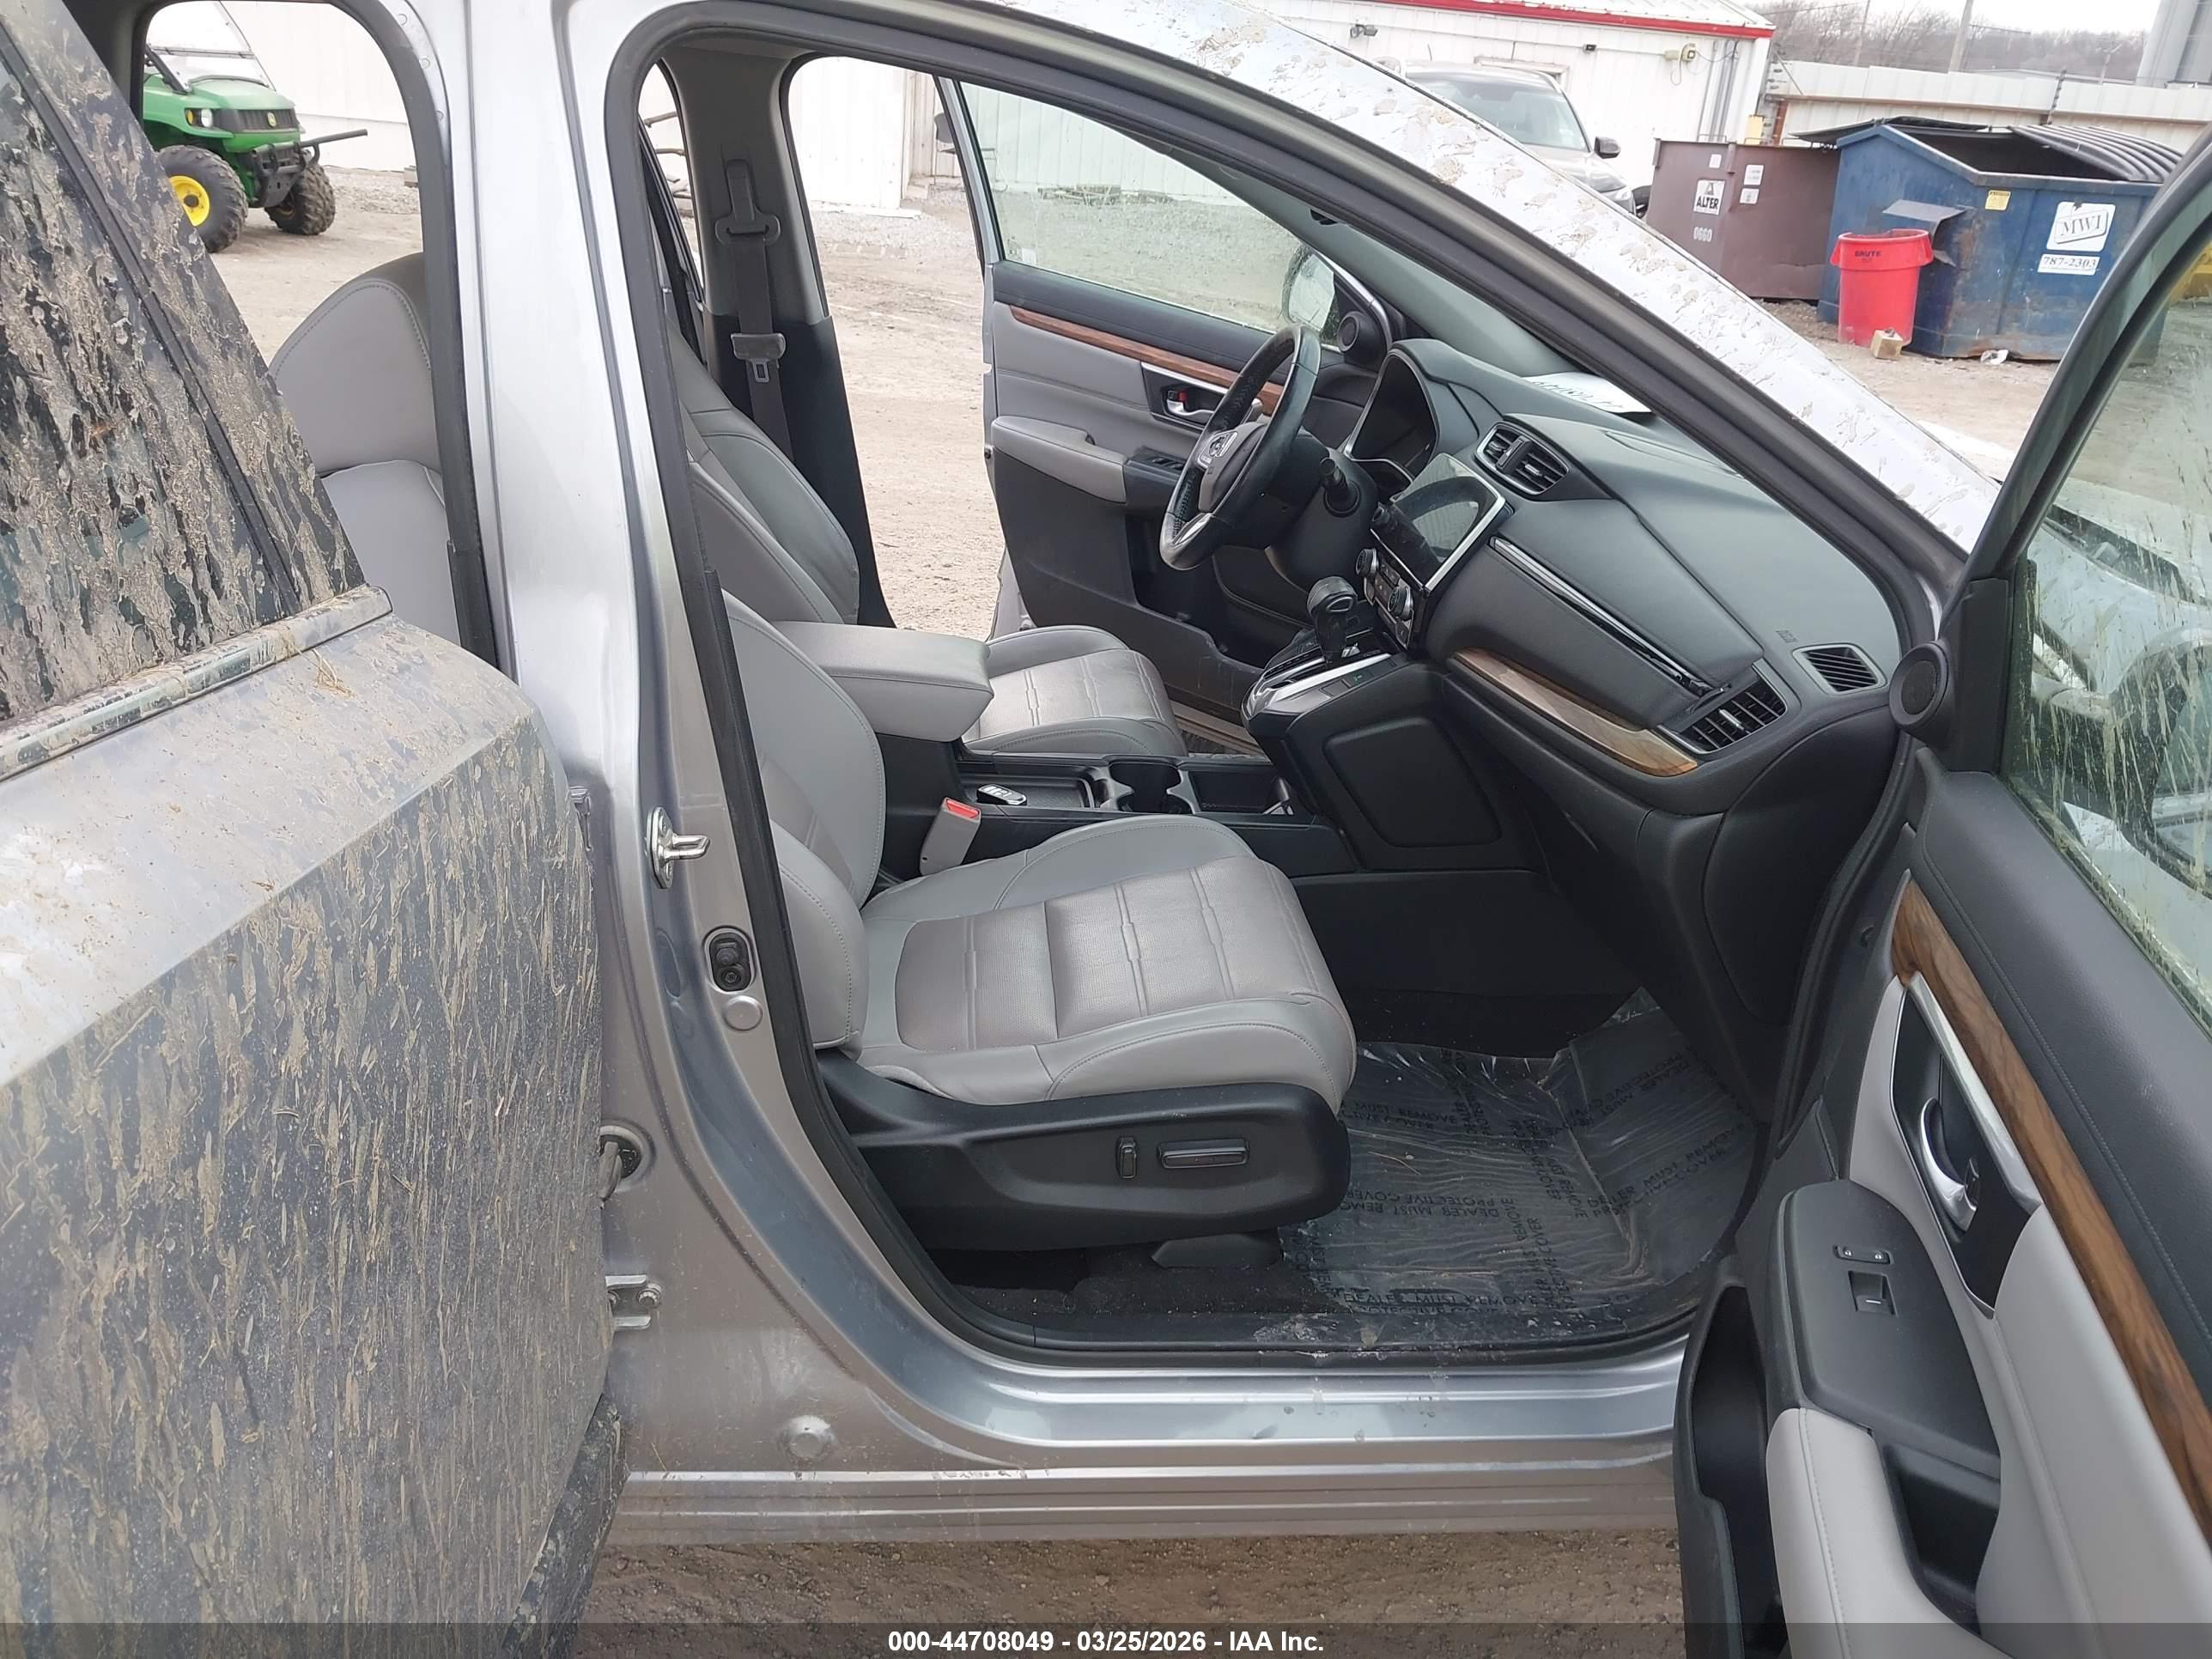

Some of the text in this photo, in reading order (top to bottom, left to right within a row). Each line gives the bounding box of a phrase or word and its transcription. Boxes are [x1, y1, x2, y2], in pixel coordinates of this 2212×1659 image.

[1697, 196, 1719, 210] ALTER
[2056, 214, 2102, 236] MWI
[2042, 256, 2098, 269] 787-2303
[1344, 1189, 1495, 1207] PROTECTIVE COVER
[1340, 1200, 1499, 1218] DEALER MUST REMO
